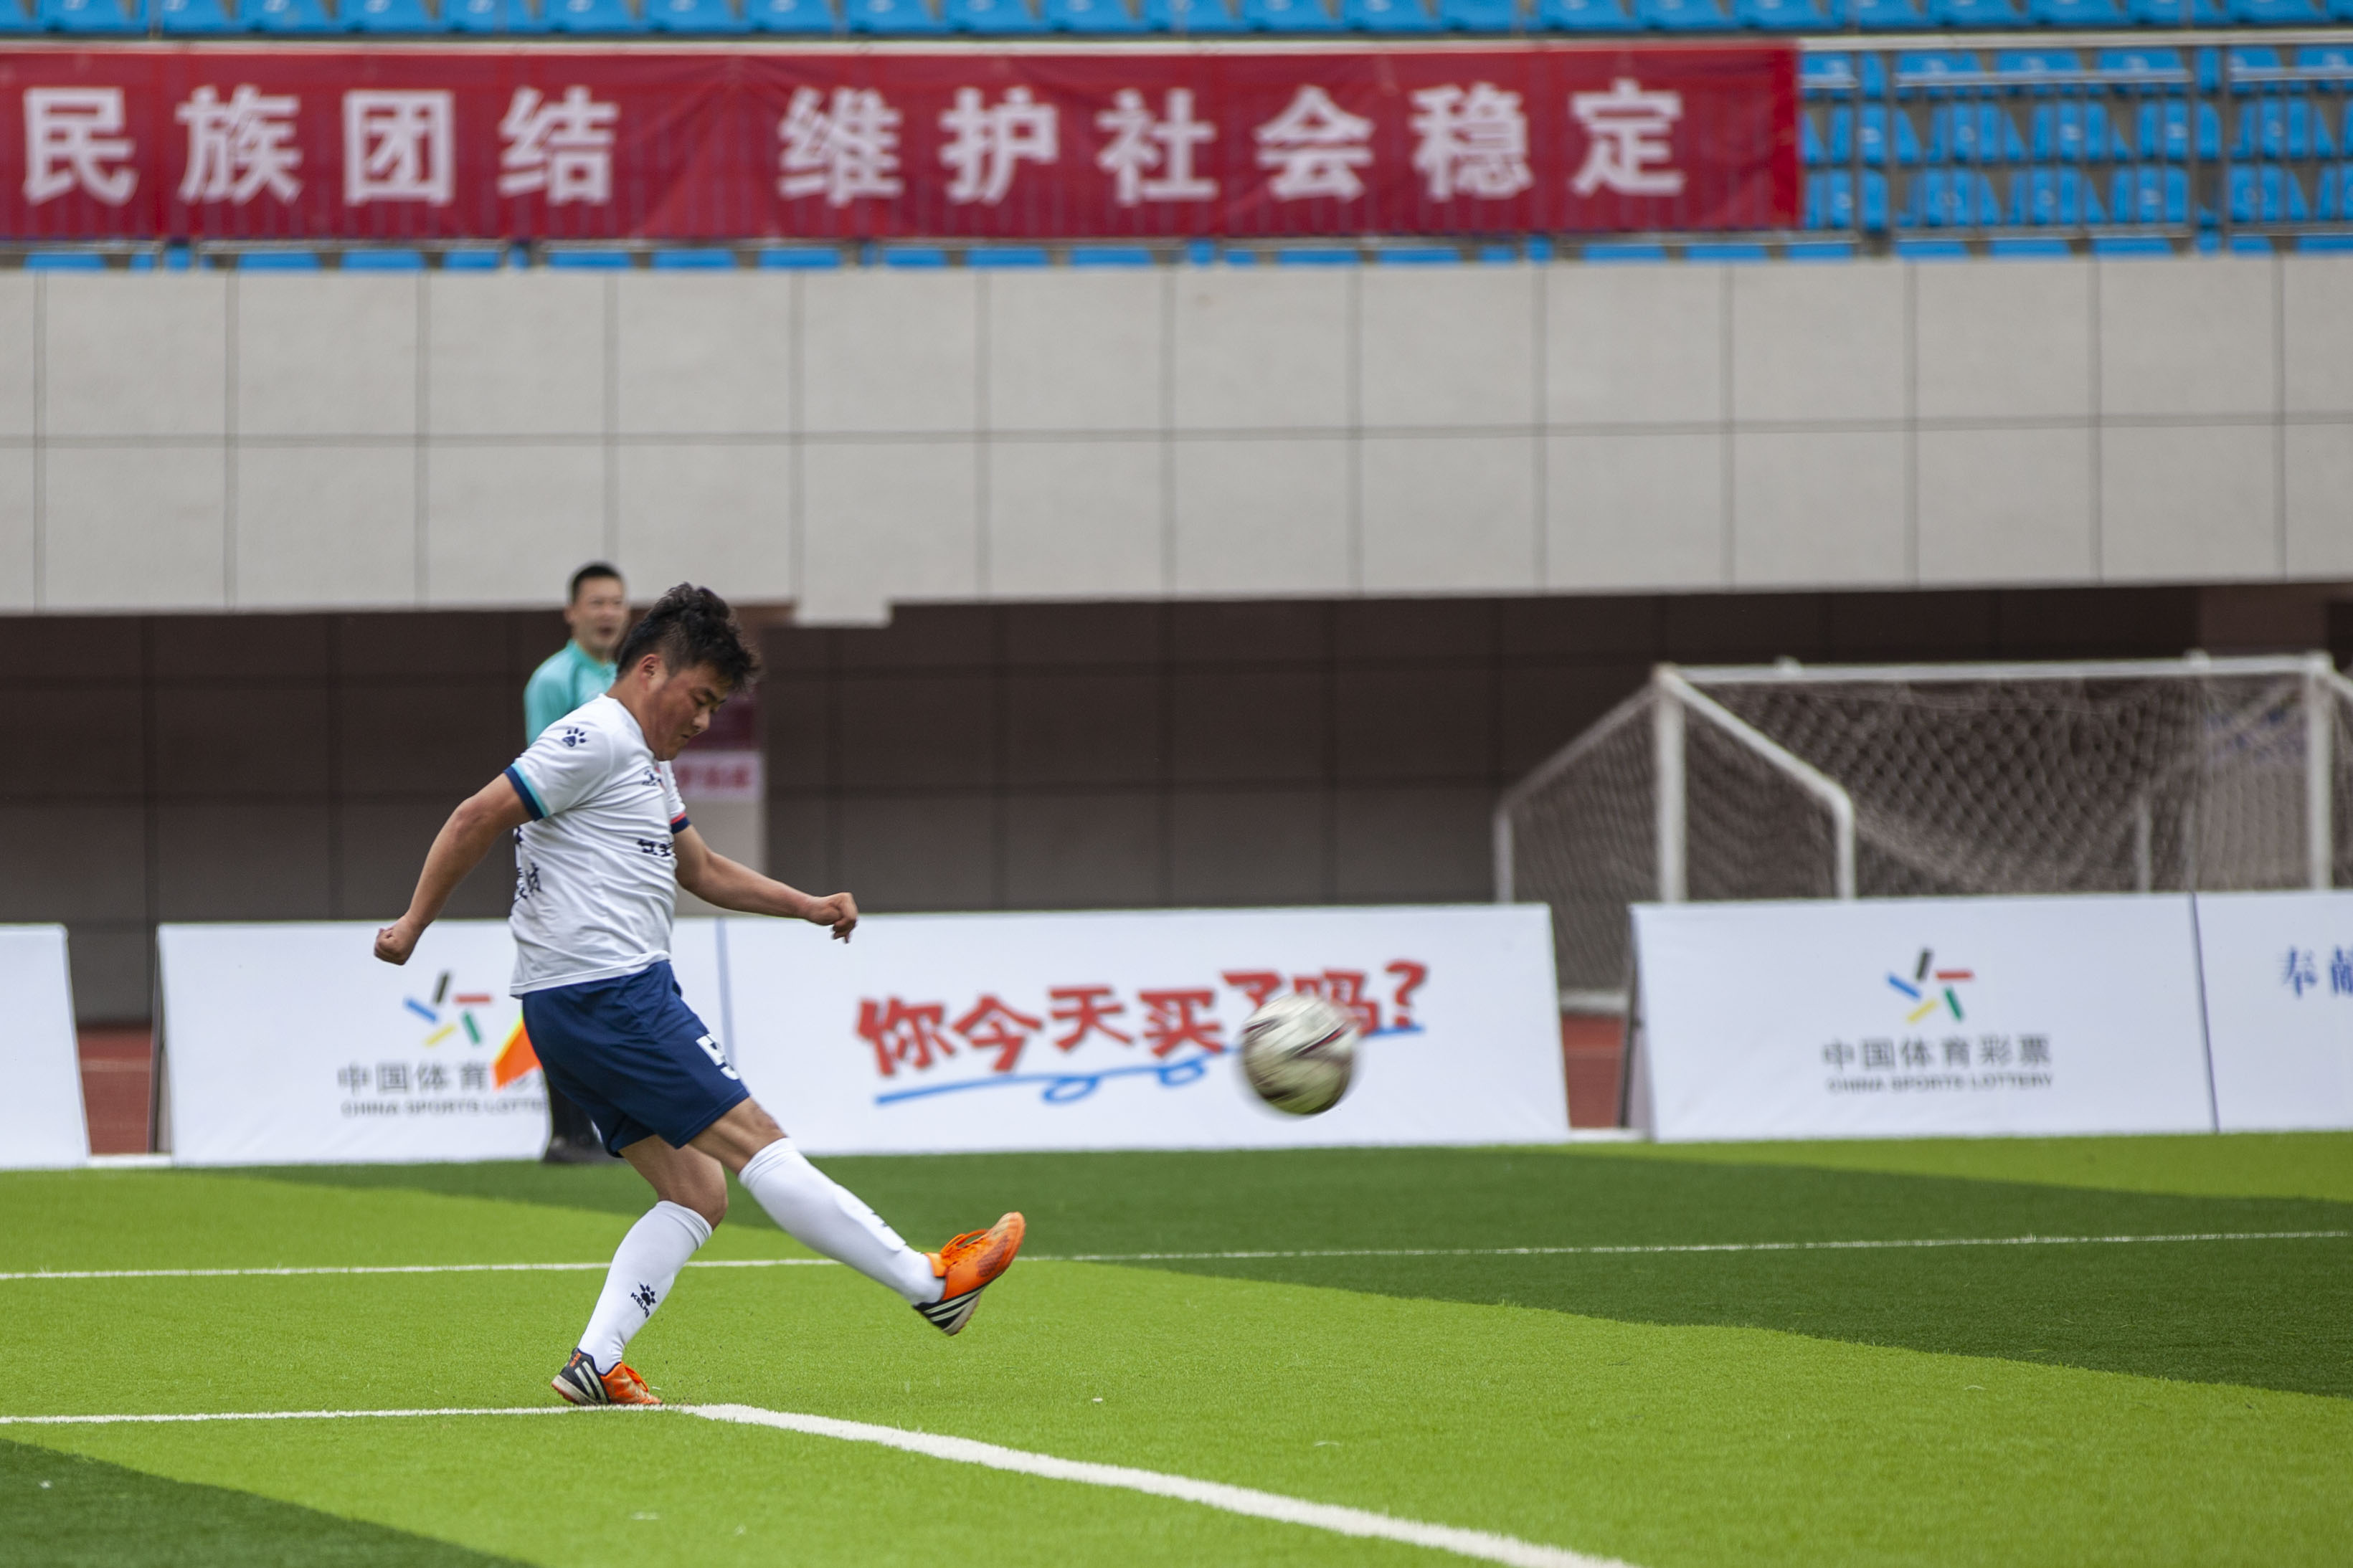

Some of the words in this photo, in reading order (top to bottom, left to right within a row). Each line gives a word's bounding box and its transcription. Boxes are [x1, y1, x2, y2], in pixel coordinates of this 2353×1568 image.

[22, 83, 620, 206] 民族团结
[777, 77, 1688, 208] 维护社会稳定
[1822, 1035, 2051, 1070] 中国体育彩票
[338, 1061, 546, 1094] 中国体育
[1827, 1077, 1885, 1093] CHINA
[1890, 1075, 1965, 1091] SPORTS
[1971, 1074, 2053, 1090] LOTTERY
[340, 1100, 399, 1116] CHINA
[403, 1098, 479, 1114] SPORTS
